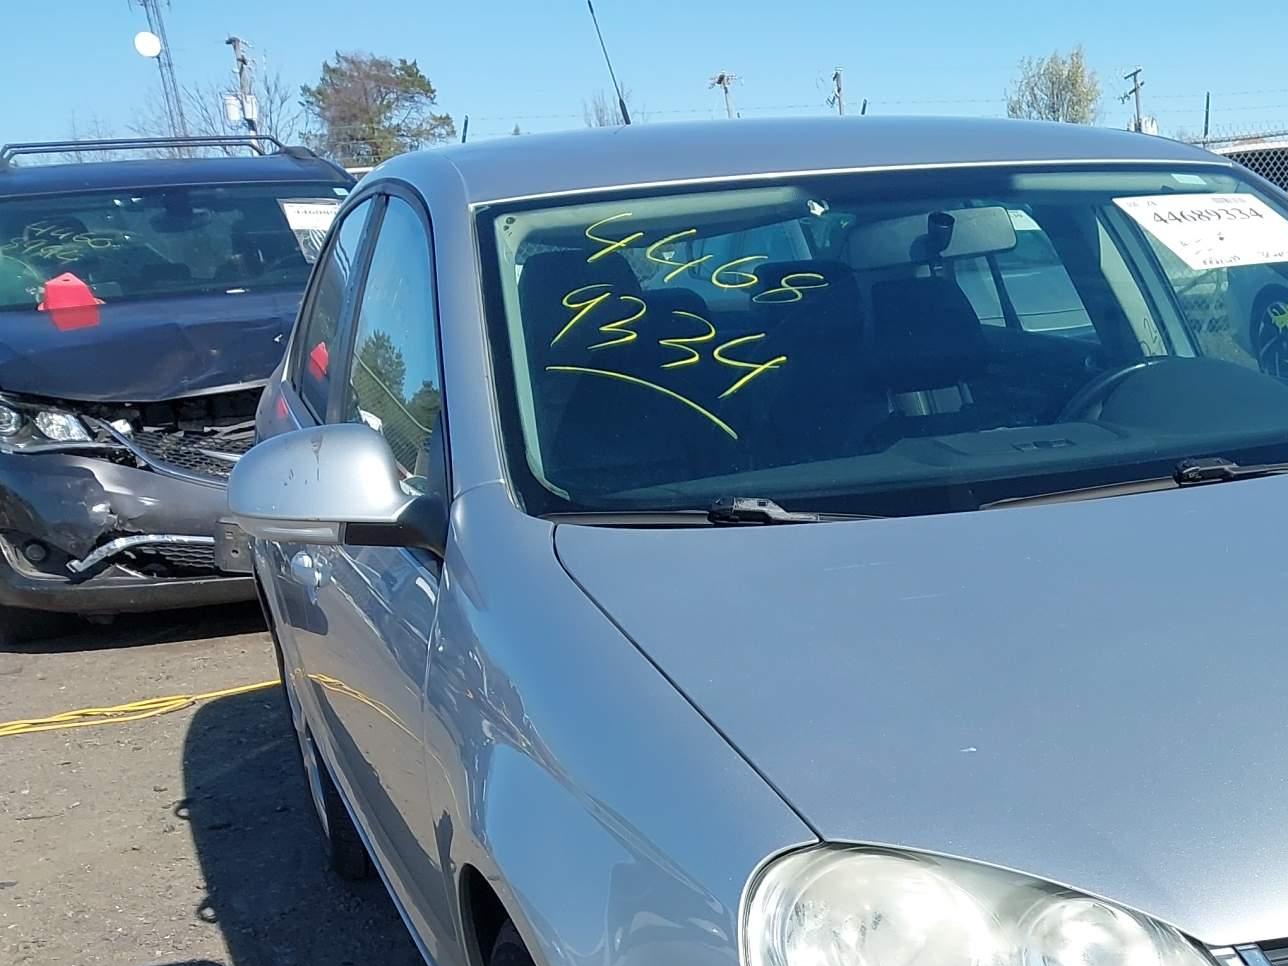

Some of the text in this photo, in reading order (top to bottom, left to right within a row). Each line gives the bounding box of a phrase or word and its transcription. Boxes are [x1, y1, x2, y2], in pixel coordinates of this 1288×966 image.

[585, 212, 830, 304] 4468
[1153, 207, 1264, 225] 44689334
[550, 283, 788, 400] 9334
